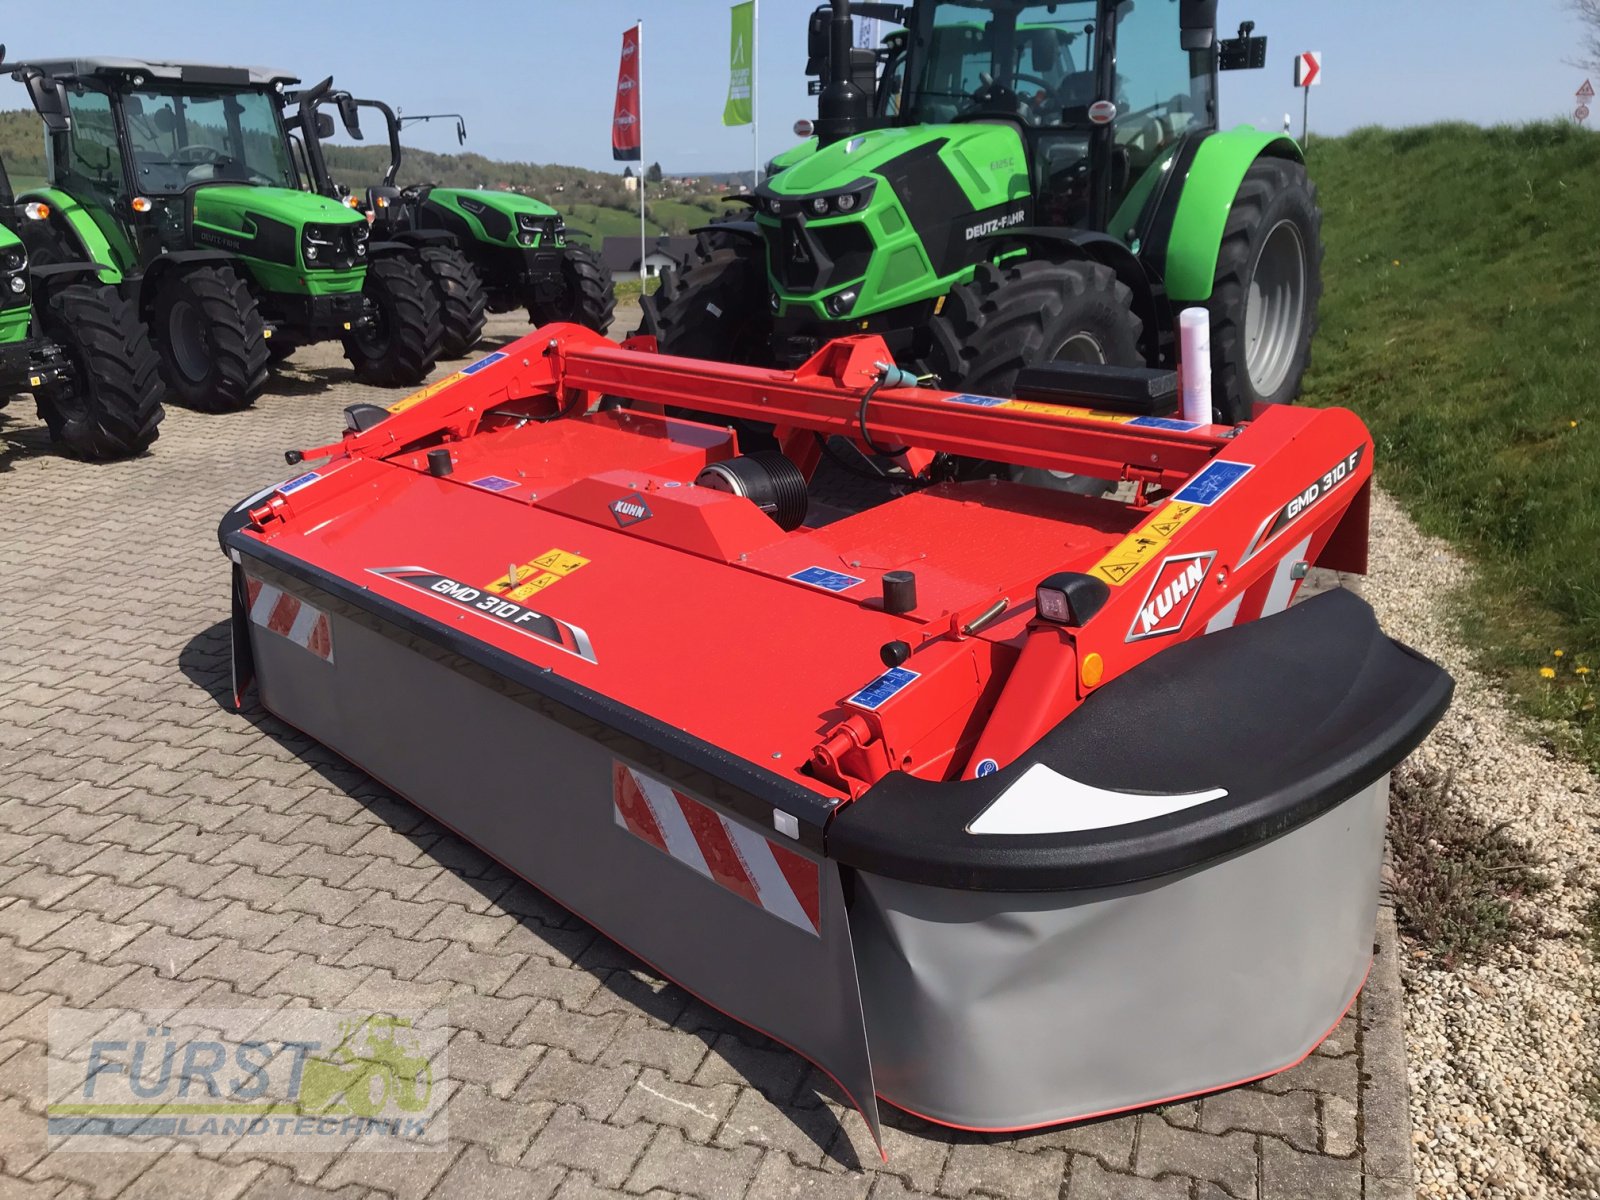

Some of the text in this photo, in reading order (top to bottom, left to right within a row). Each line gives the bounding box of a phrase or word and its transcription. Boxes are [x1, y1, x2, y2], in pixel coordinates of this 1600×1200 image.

[965, 210, 1025, 240] DEUTZ-FAHR
[1287, 451, 1358, 519] GMD 310 F
[614, 500, 646, 518] KUHN
[430, 579, 542, 623] GMD 310 F
[1140, 557, 1204, 634] KUHN
